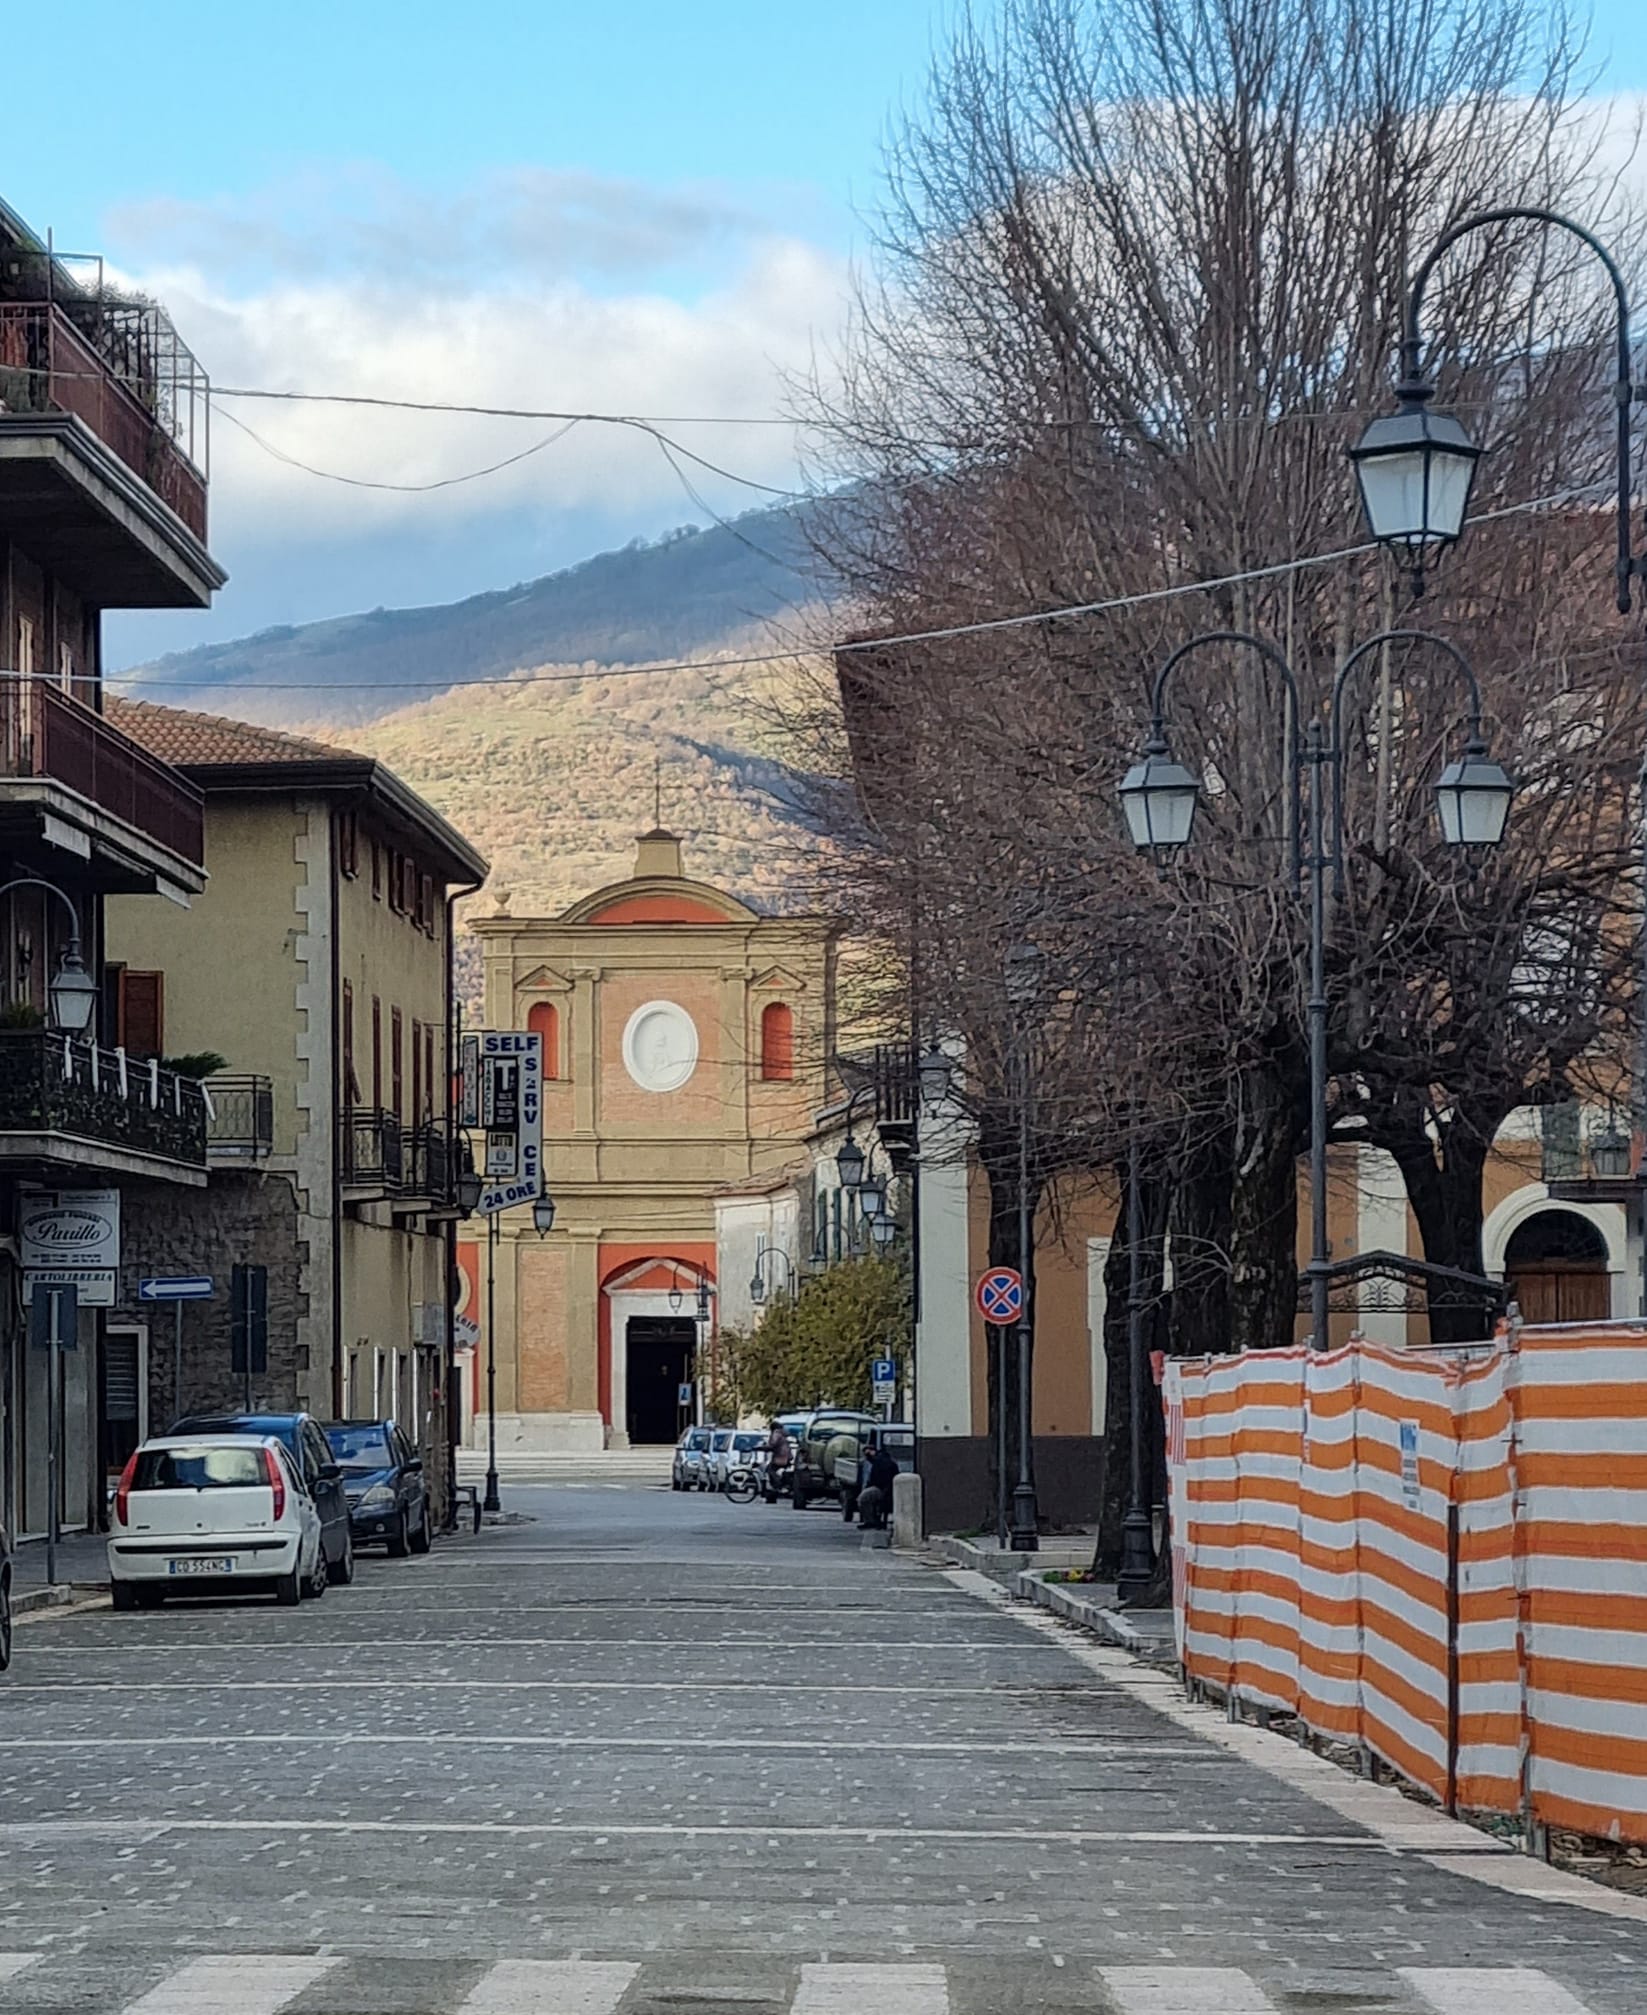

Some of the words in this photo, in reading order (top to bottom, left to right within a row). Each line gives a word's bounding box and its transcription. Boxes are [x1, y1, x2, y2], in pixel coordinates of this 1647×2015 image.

[485, 1036, 539, 1052] SELF
[484, 1192, 504, 1208] 24
[506, 1181, 537, 1201] ORE
[877, 1362, 891, 1380] P
